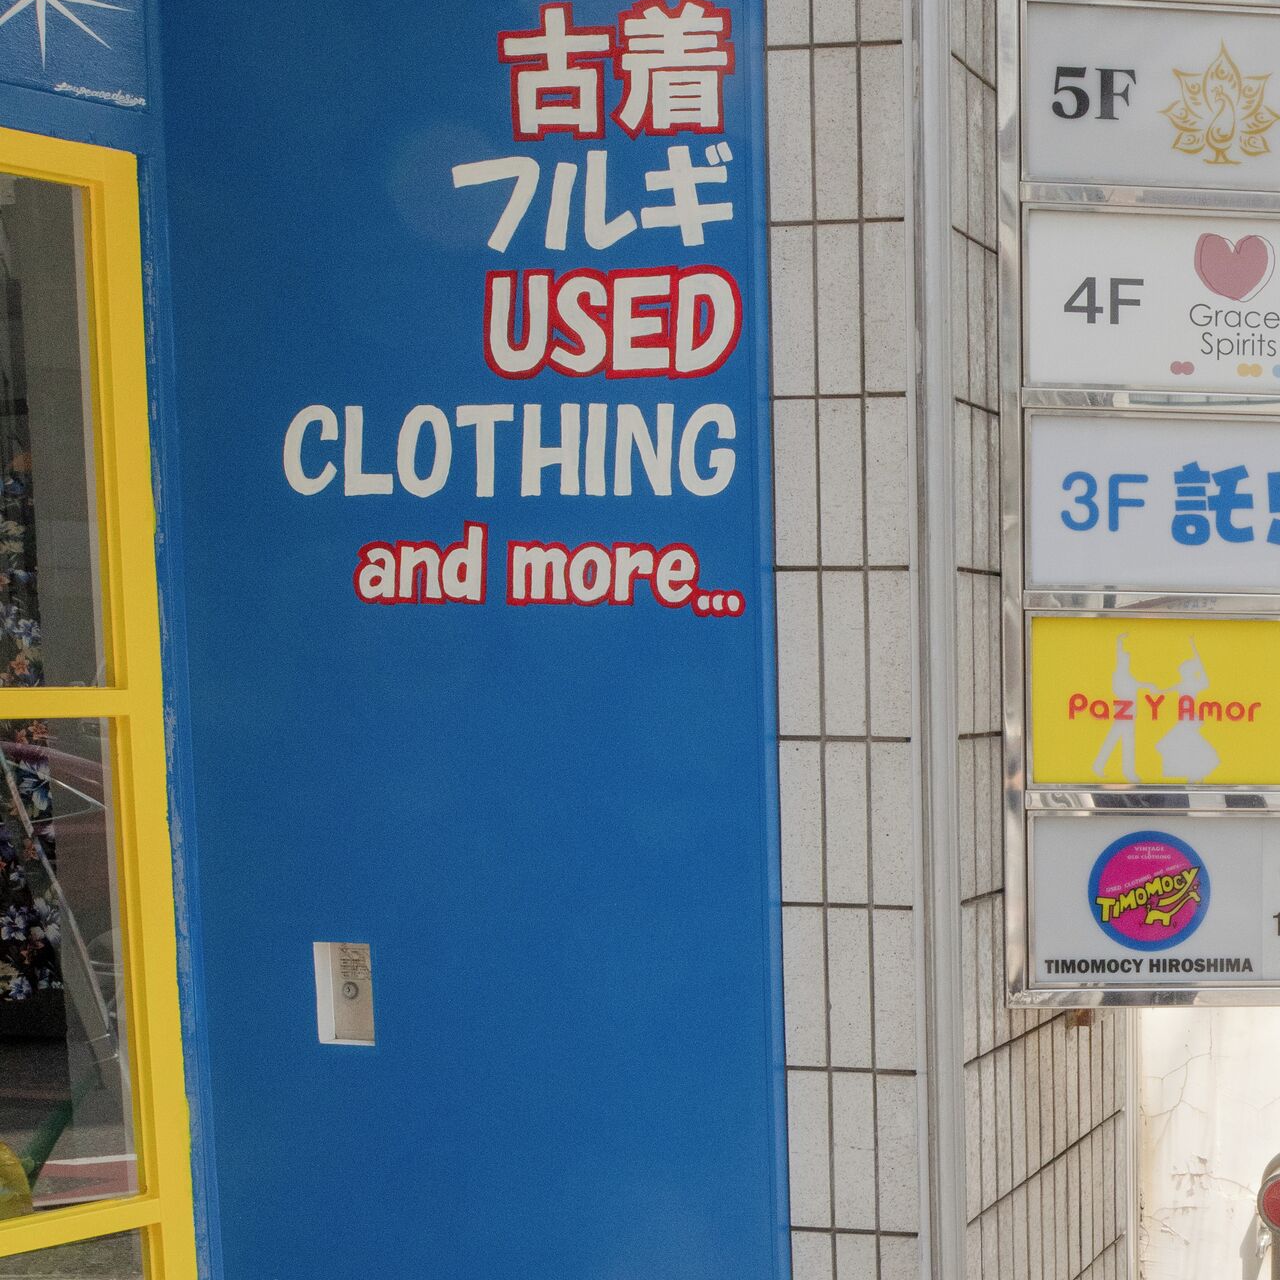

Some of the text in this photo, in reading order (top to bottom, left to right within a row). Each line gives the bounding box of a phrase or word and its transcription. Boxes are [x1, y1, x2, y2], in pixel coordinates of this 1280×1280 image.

[1051, 66, 1138, 122] 5F
[452, 141, 734, 254] フルギ
[484, 265, 743, 380] USED
[1063, 277, 1144, 326] 4F
[1189, 303, 1280, 331] Grace
[1200, 331, 1278, 362] Spirits
[283, 402, 738, 499] CLOTHING
[1060, 470, 1149, 534] 3F
[354, 521, 488, 606] and
[1068, 693, 1263, 723] Paz Y Amor
[1095, 866, 1201, 923] TIMOMOCY
[1044, 957, 1254, 975] TIMOMOCY HIROSHIMA
